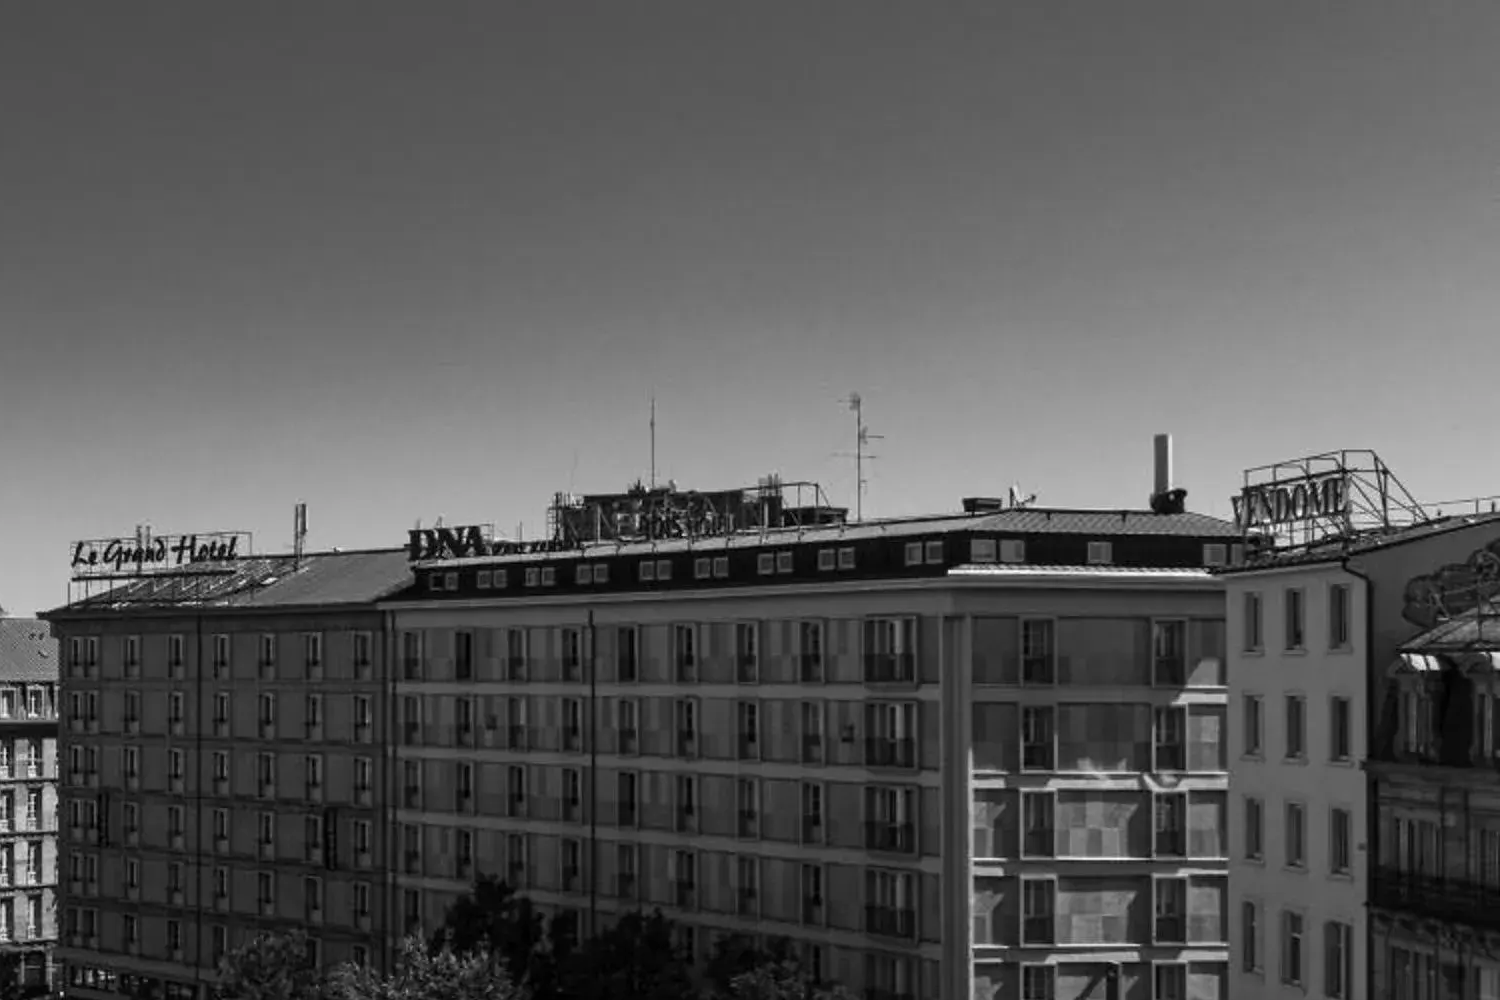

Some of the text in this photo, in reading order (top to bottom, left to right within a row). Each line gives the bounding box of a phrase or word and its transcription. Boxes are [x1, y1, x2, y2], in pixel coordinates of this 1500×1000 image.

[1230, 477, 1349, 528] VENDOME
[71, 534, 239, 571] Le Grand Hotel
[408, 525, 483, 561] DNA
